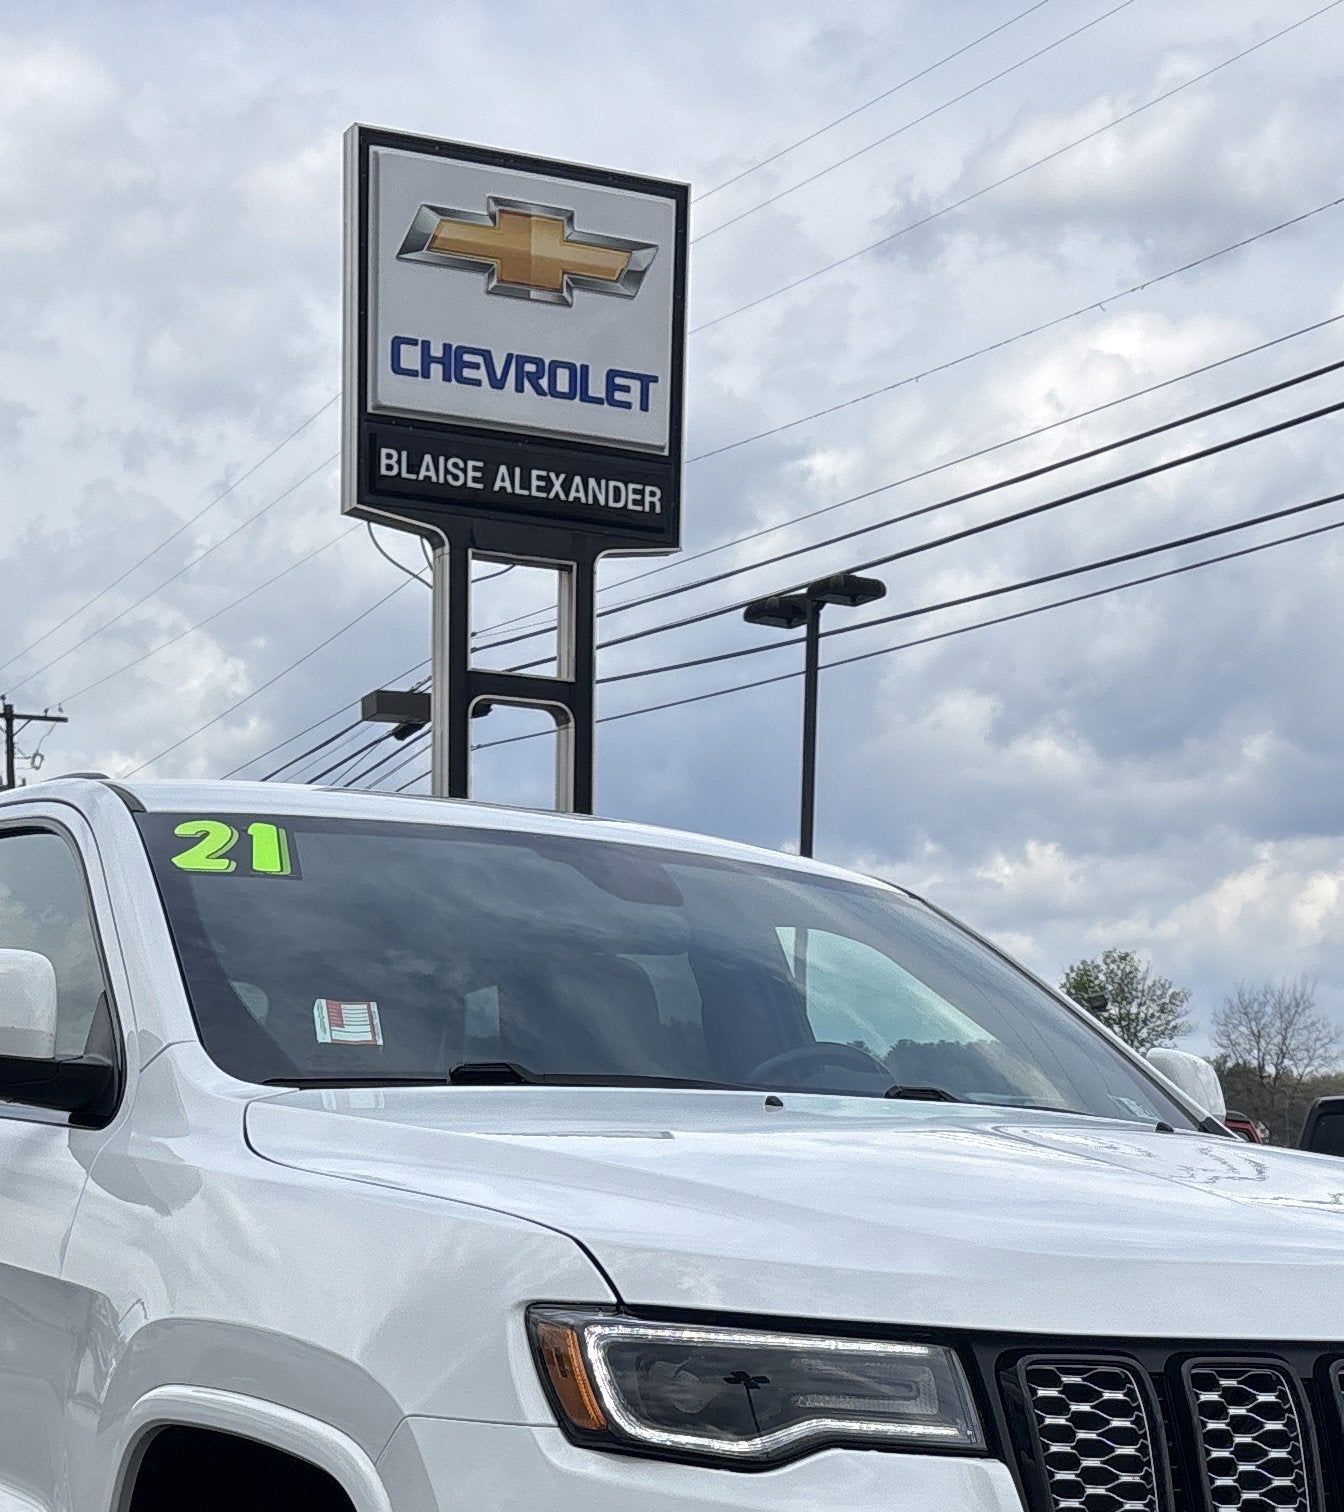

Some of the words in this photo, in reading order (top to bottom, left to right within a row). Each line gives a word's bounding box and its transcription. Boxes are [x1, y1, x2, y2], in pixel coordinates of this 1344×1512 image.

[389, 335, 660, 412] CHEVROLET
[378, 446, 486, 490] BLAISE
[492, 463, 663, 515] ALEXANDER
[170, 820, 291, 876] 21
